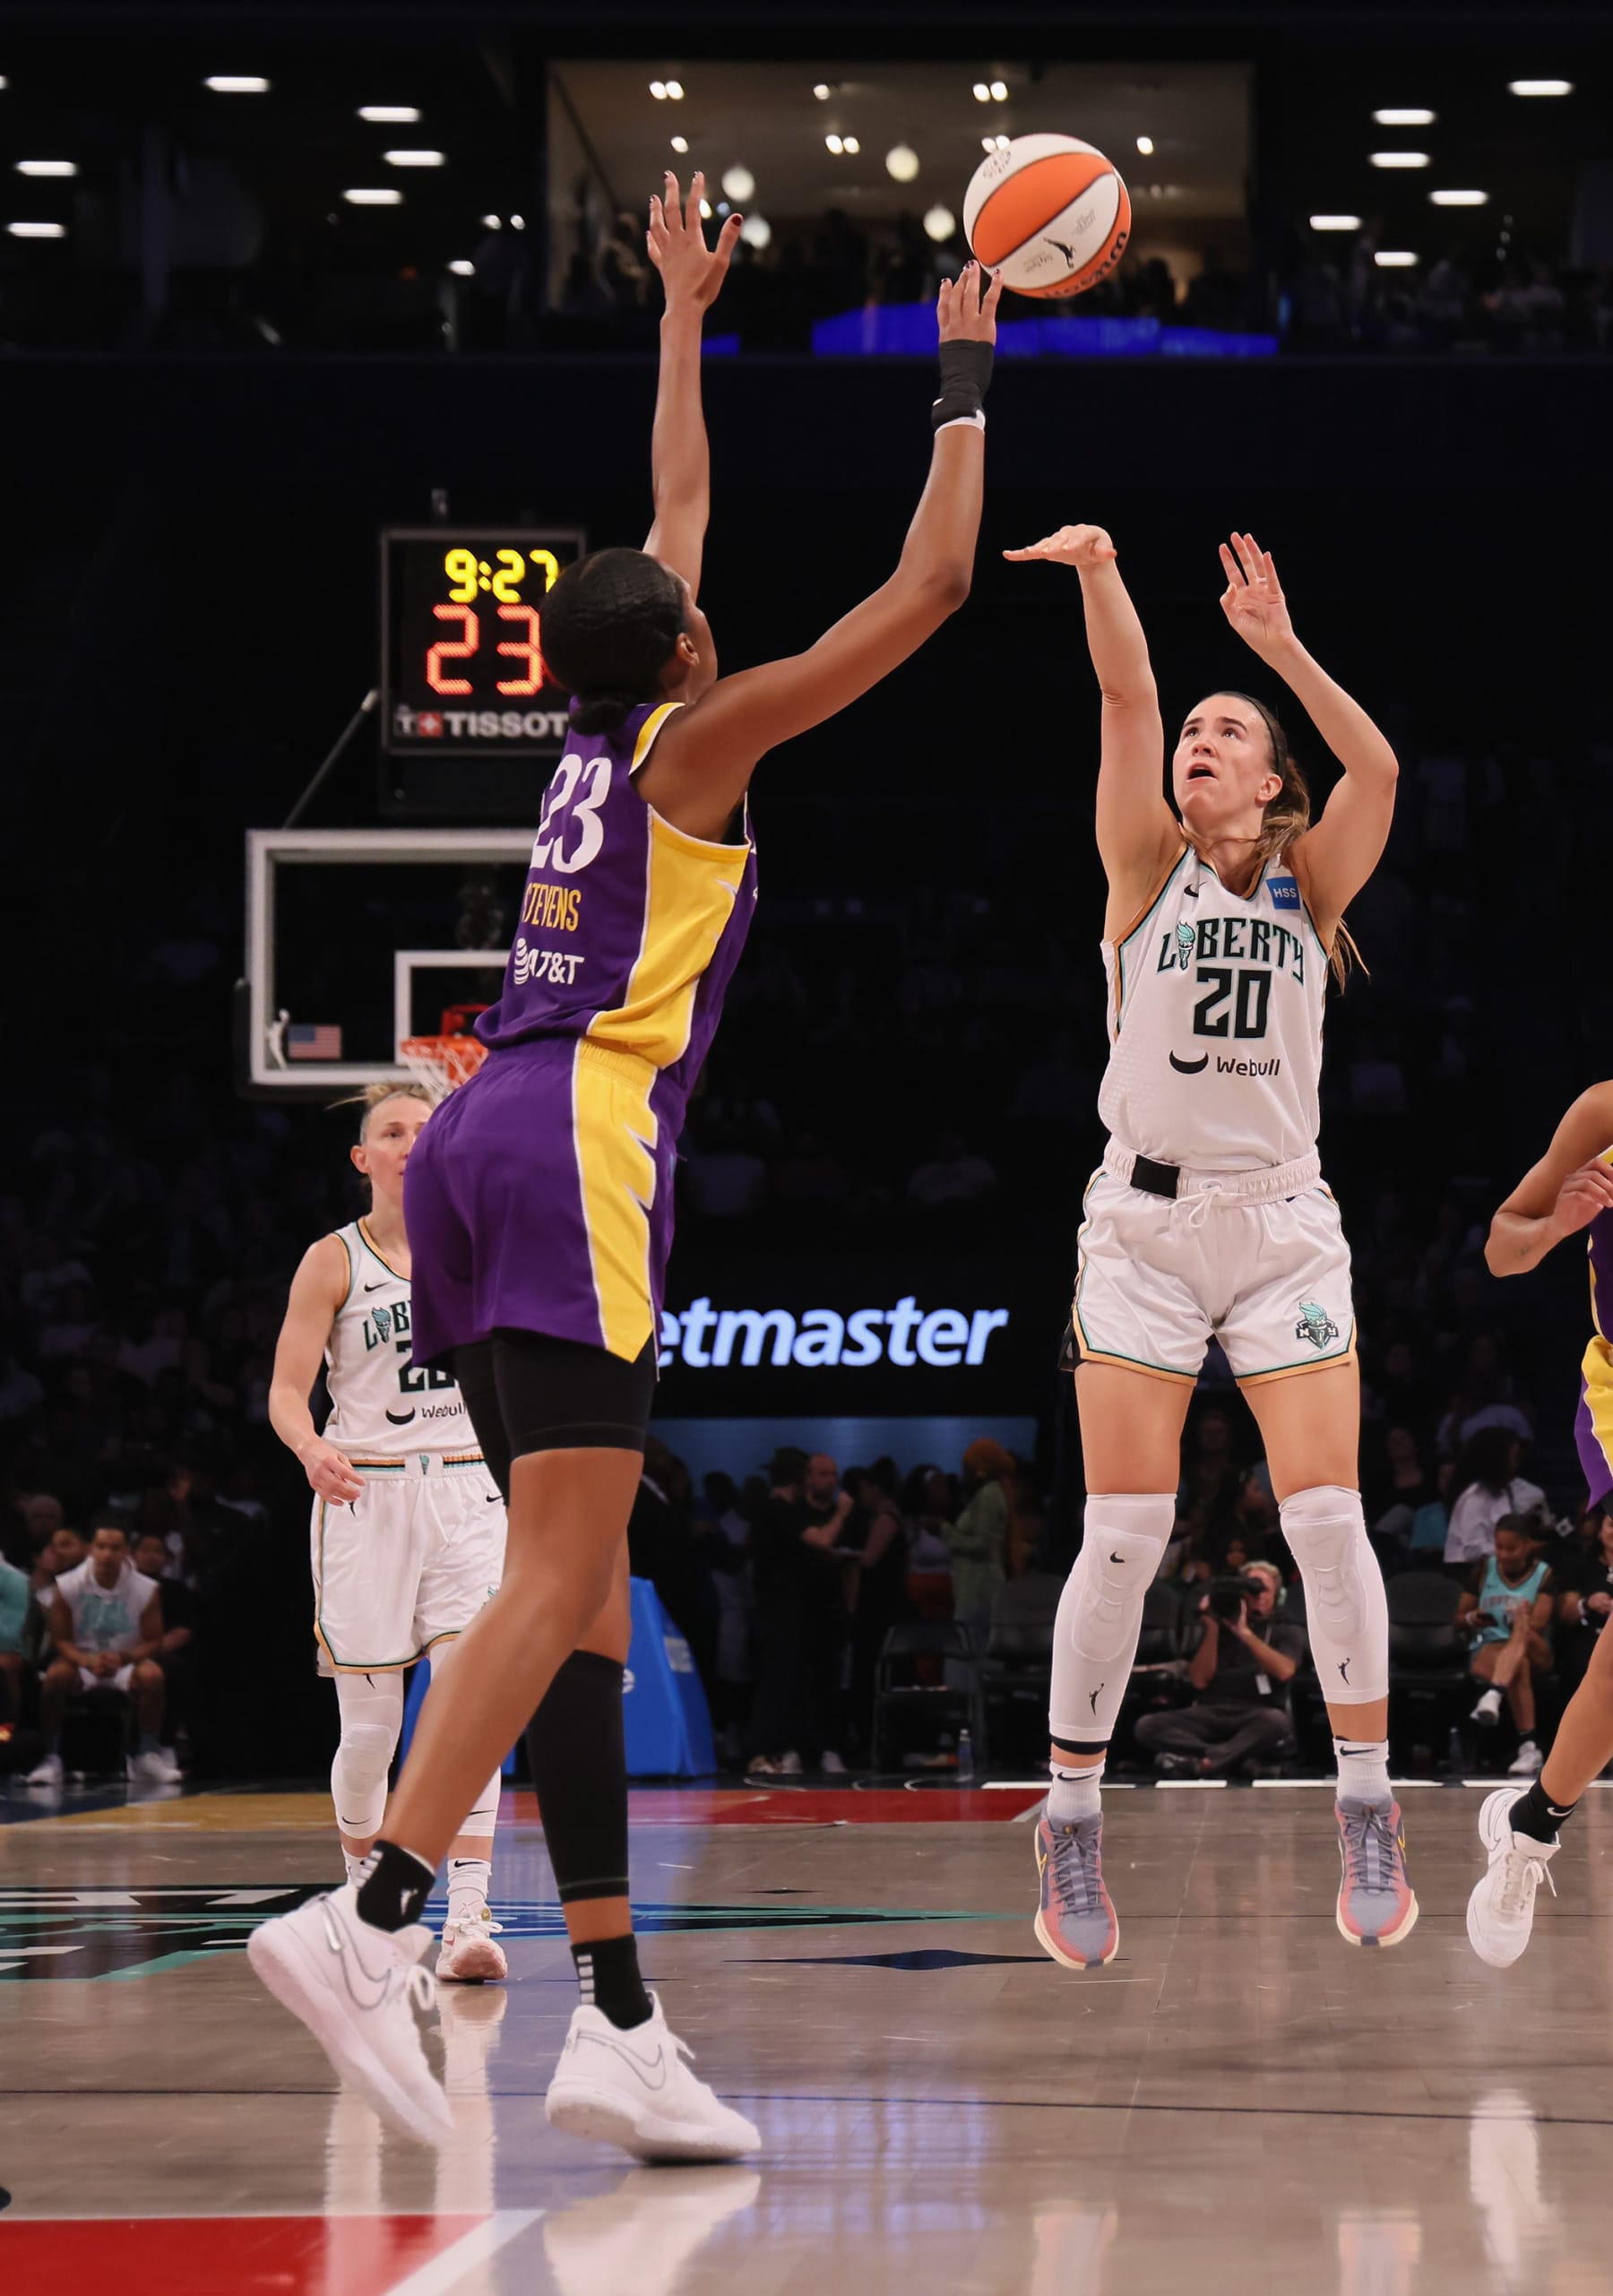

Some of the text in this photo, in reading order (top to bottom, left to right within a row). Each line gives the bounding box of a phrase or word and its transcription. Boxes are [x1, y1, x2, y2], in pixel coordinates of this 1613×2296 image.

[444, 548, 559, 603] 9:27
[426, 604, 544, 696] 23
[443, 711, 571, 738] TISSOT
[530, 754, 612, 874] 23
[1272, 887, 1298, 899] HSS
[527, 947, 585, 985] AT&T
[1193, 967, 1272, 1039] 20
[1216, 1056, 1281, 1076] Webull
